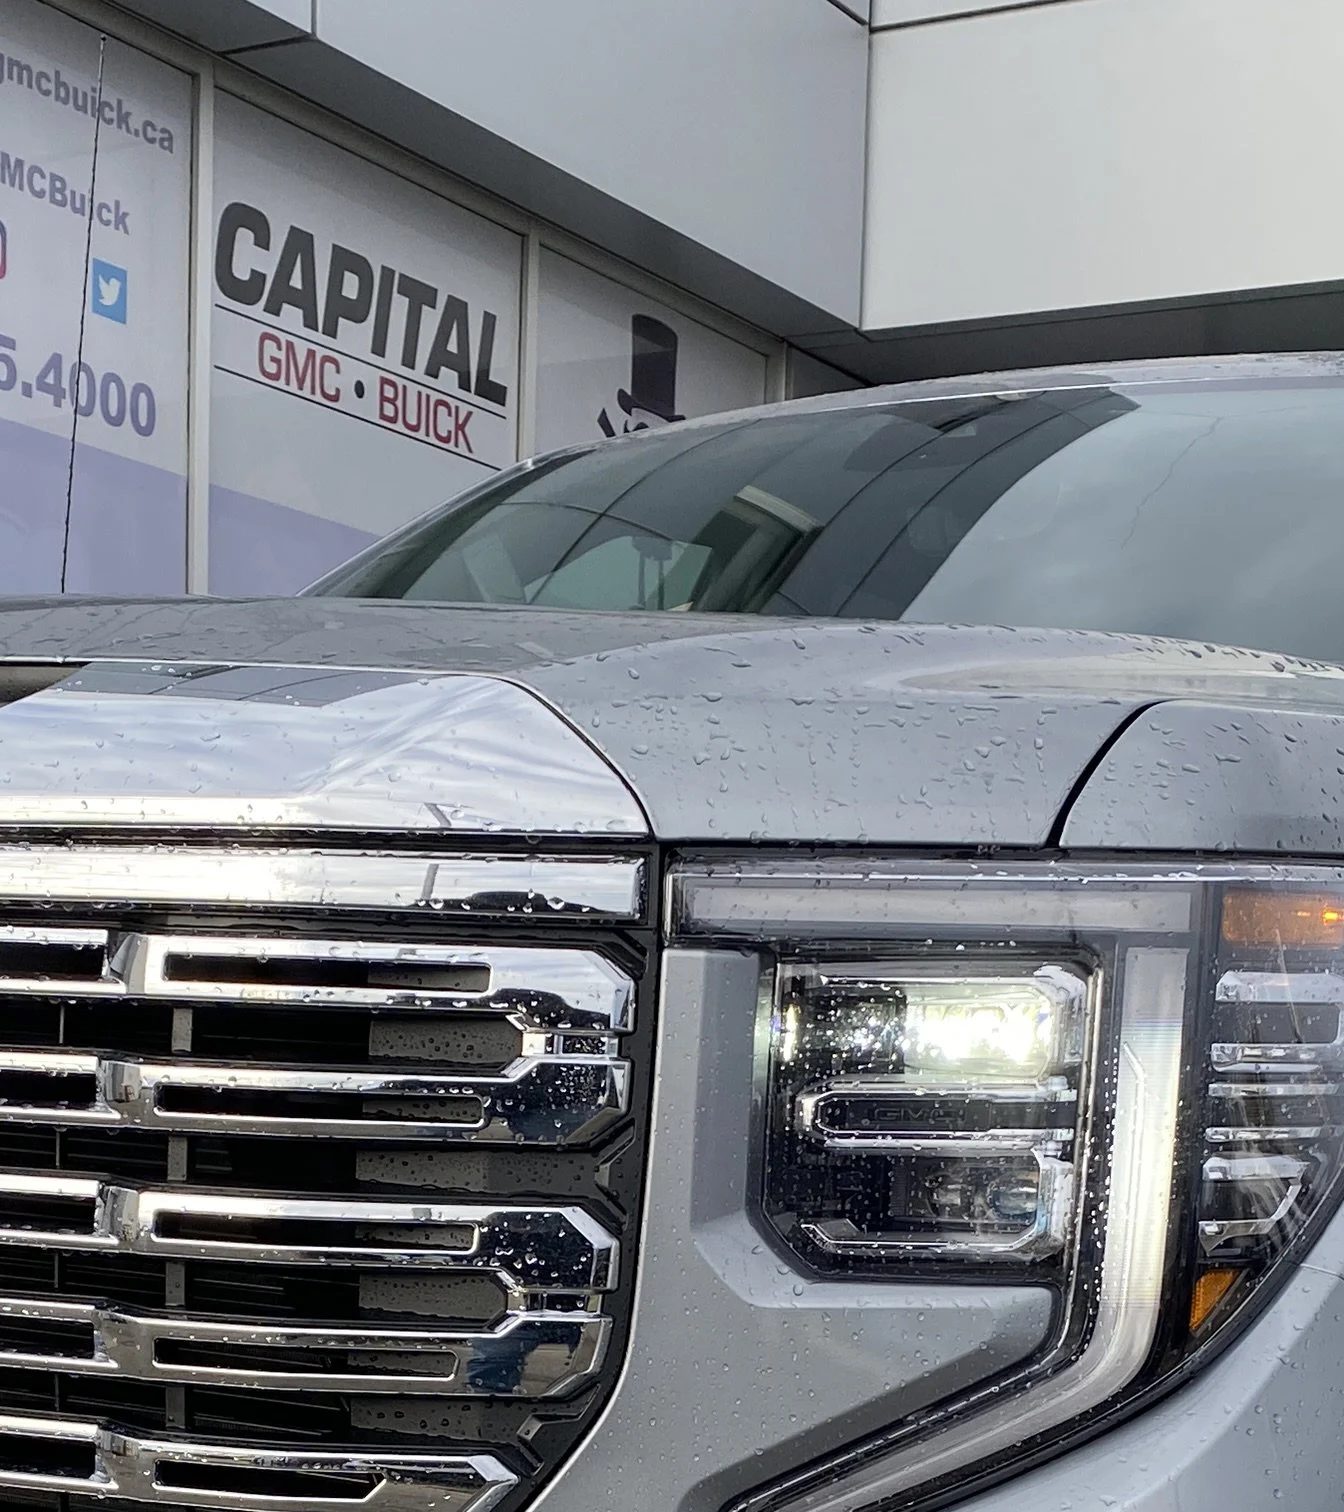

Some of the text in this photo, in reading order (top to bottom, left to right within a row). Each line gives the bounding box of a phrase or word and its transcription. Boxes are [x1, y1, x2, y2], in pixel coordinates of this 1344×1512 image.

[215, 202, 507, 407] CAPITAL
[258, 331, 474, 453] GMC BUICK
